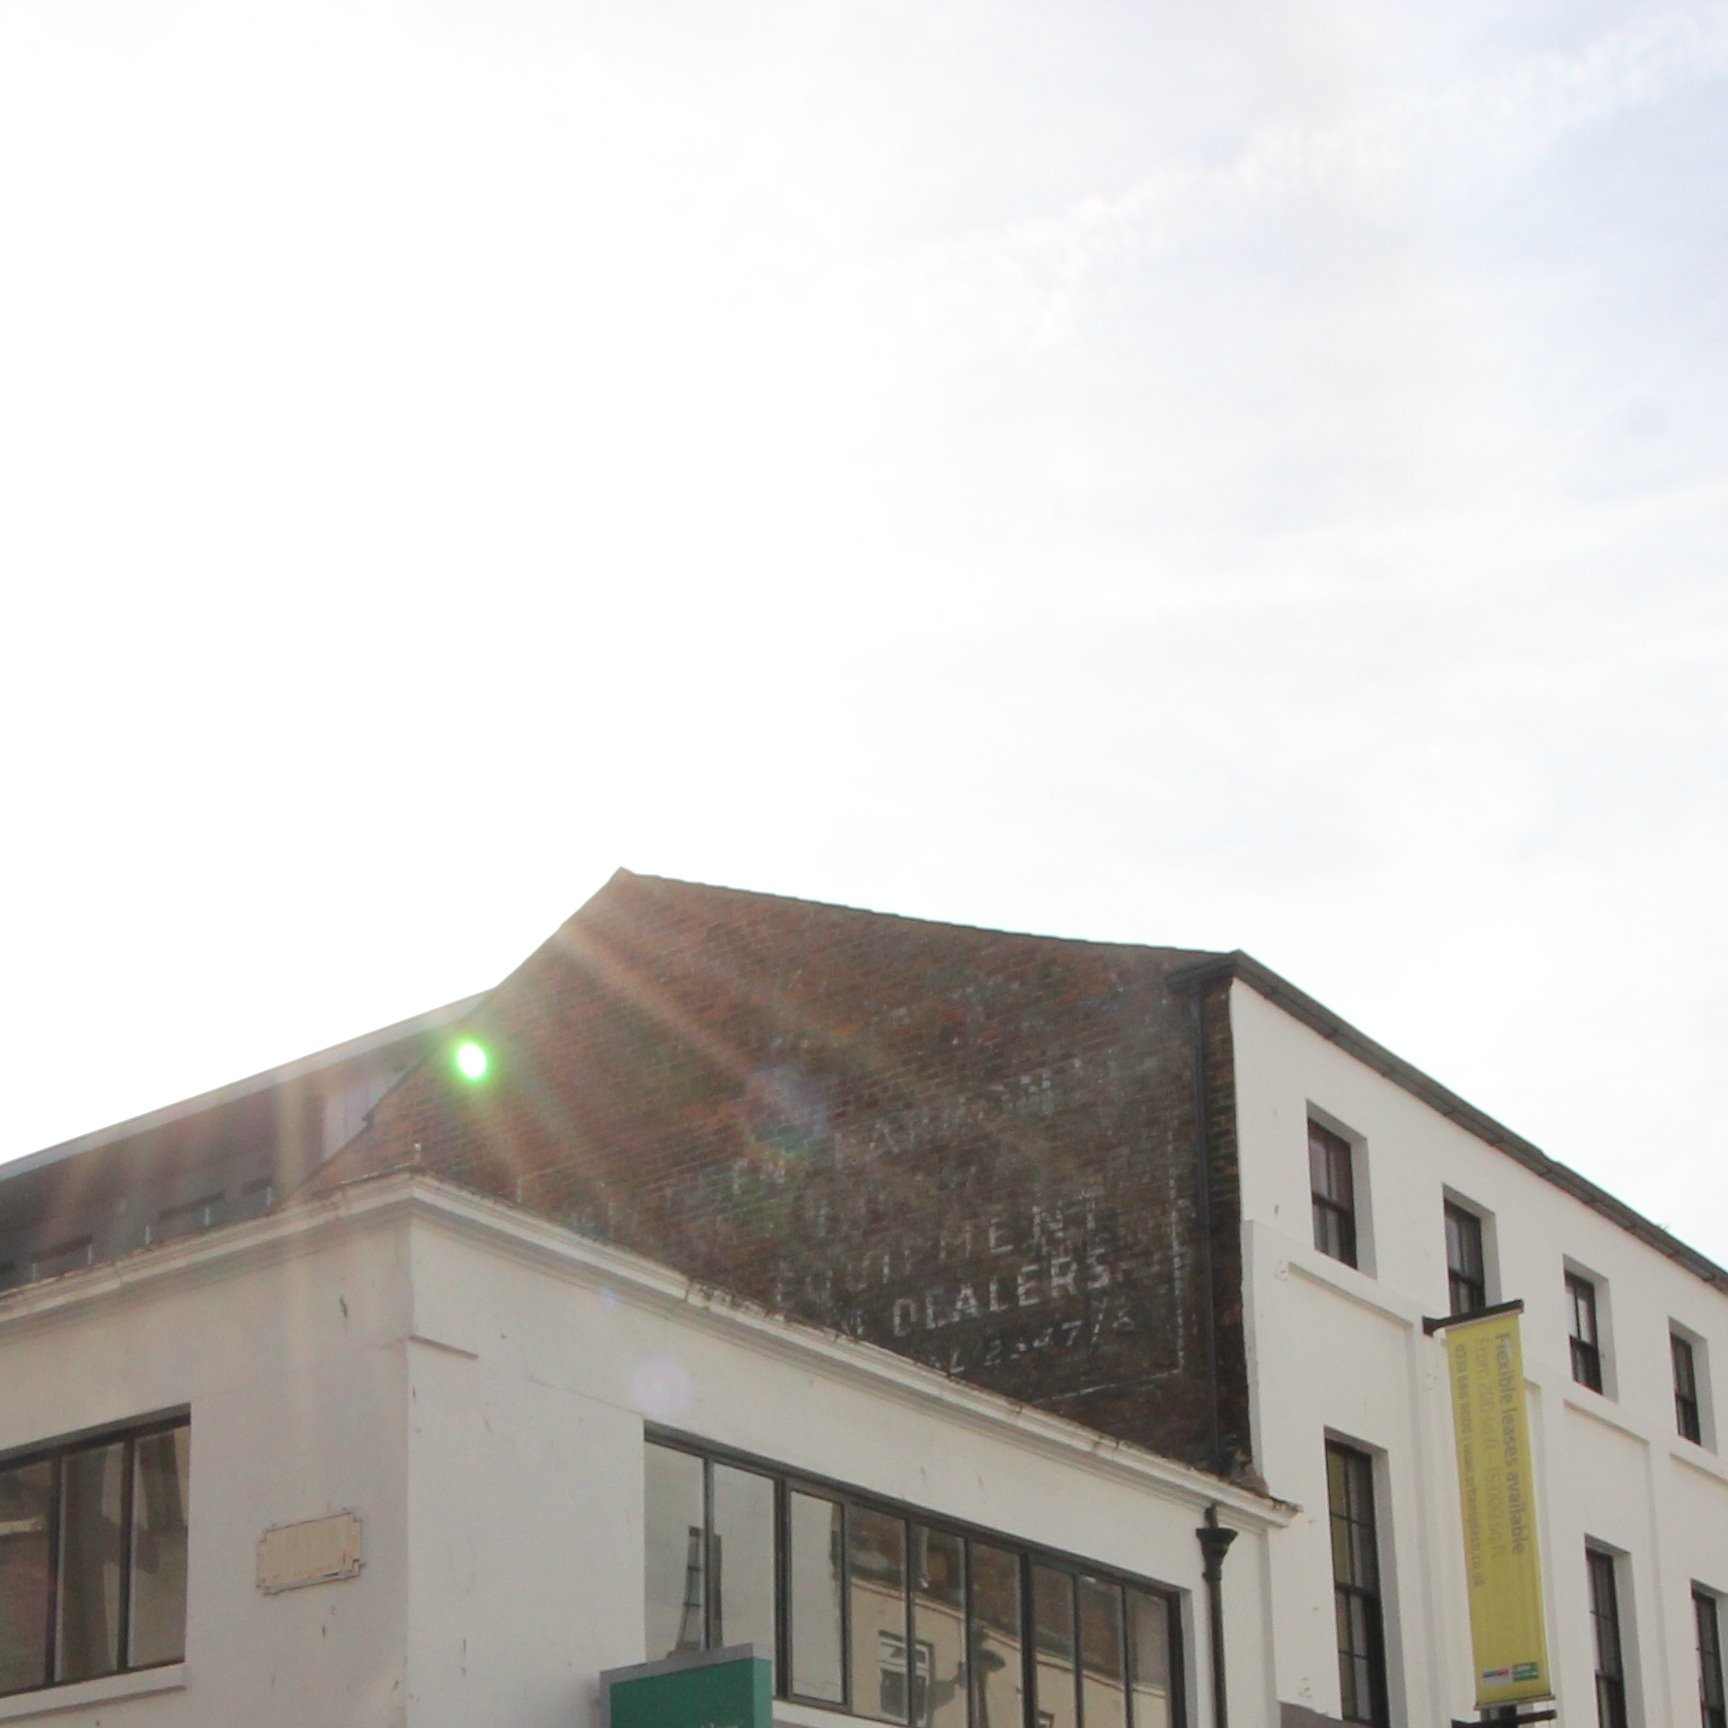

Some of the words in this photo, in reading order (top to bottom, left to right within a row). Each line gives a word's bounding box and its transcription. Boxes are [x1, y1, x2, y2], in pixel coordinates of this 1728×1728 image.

[1494, 1332, 1514, 1406] Flexible
[1502, 1406, 1521, 1468] leases
[1506, 1469, 1527, 1555] available
